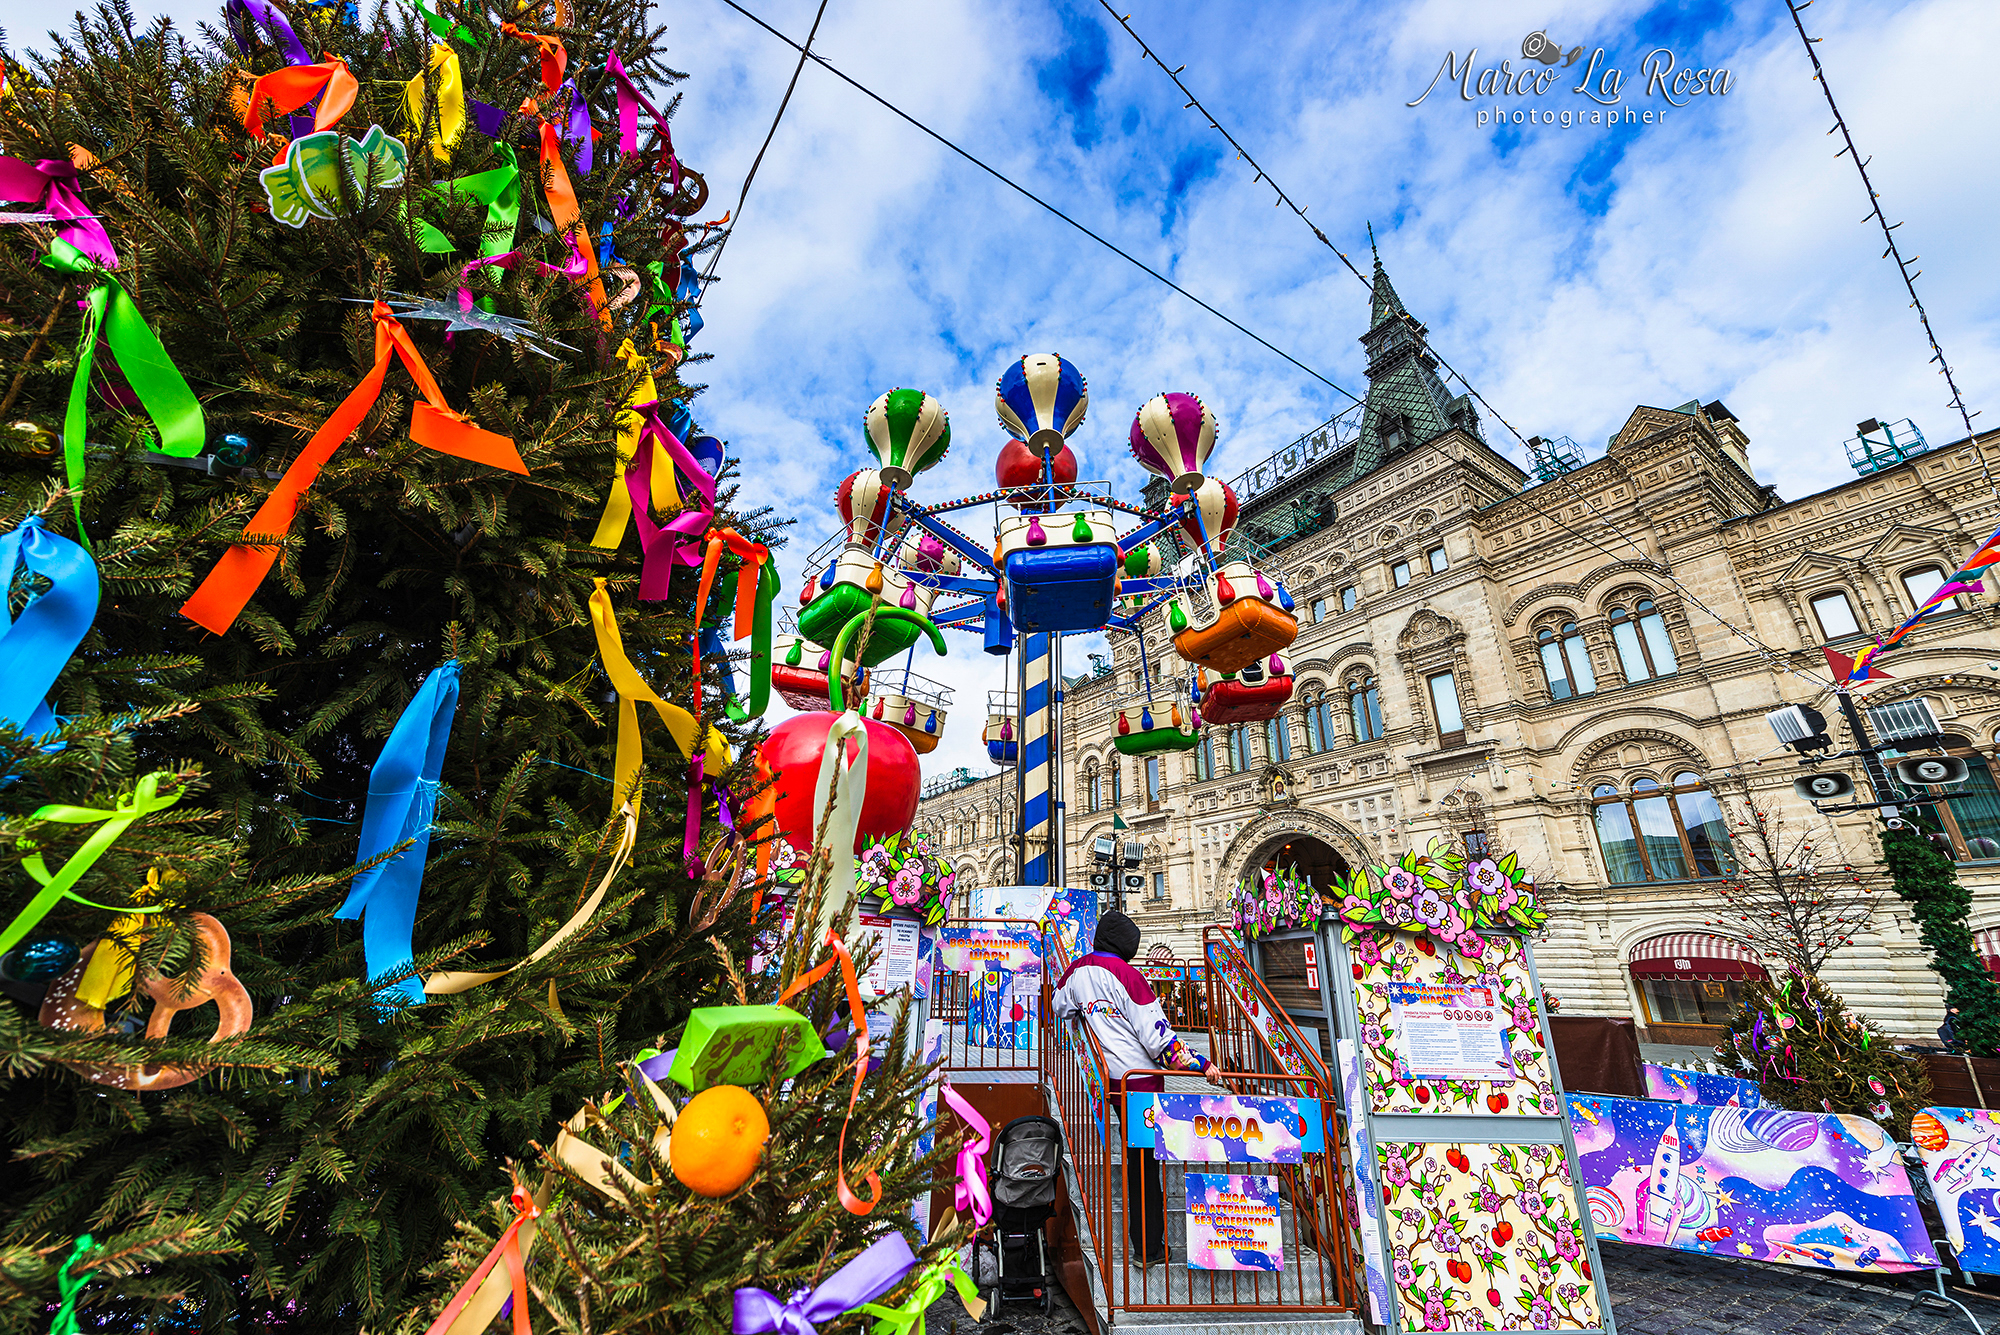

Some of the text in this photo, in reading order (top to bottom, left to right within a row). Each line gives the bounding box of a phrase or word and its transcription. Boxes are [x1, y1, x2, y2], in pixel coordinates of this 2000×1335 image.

[1254, 430, 1329, 490] ГУМ
[949, 937, 1030, 949] ВОЗДУШНЫЕ
[969, 951, 1010, 961] ШАРЫ
[1401, 985, 1466, 996] ВОЗДУШНЫЕ
[1419, 995, 1453, 1005] ШАРЫ
[1193, 1115, 1264, 1143] ВХОД
[1219, 1192, 1247, 1204] ВХОД
[1191, 1203, 1277, 1216] НА АТТРАКЦИОН
[1194, 1215, 1275, 1227] БЕЗ ОПЕРАТОРА
[1215, 1228, 1255, 1238] СТРОГО
[1207, 1239, 1268, 1251] ЗАПРЕЩЕН!
